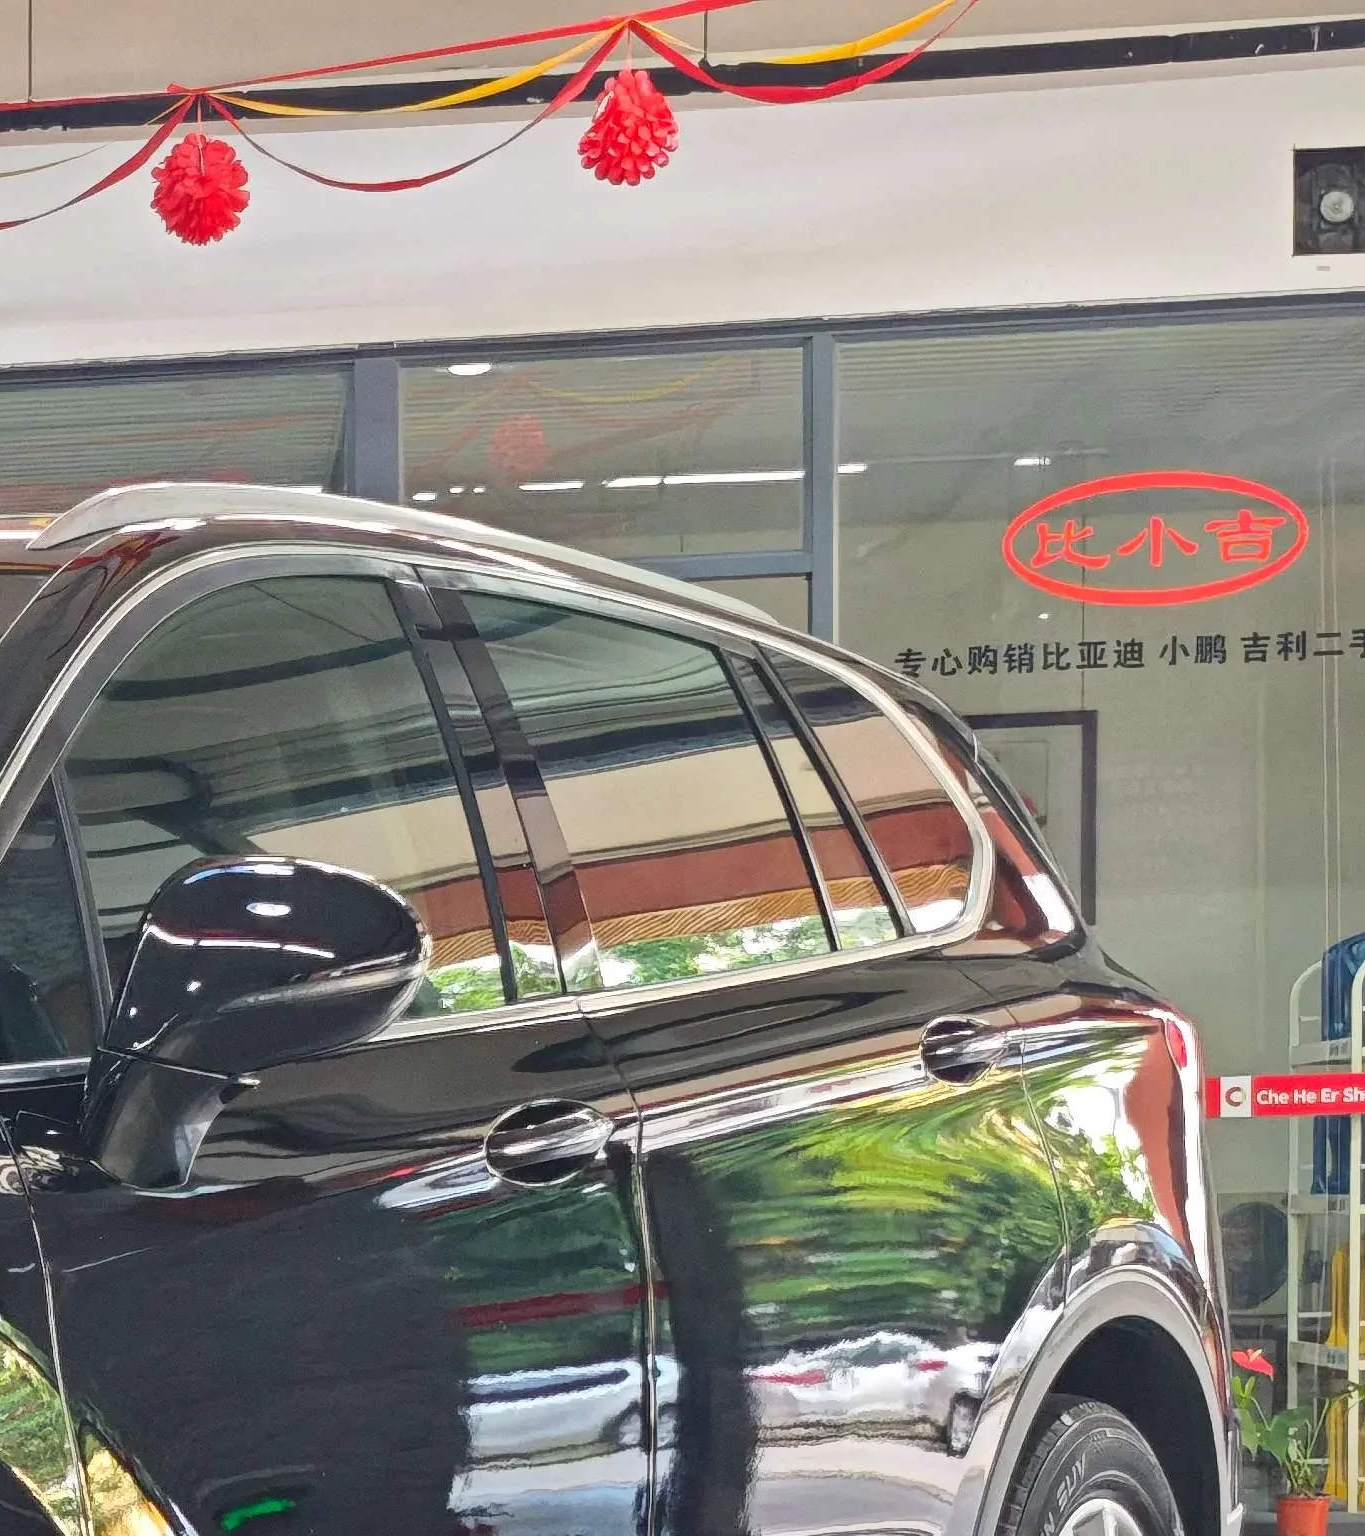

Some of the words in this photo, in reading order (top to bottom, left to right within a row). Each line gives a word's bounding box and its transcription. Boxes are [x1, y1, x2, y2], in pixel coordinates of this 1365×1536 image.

[1030, 509, 1287, 570] 比小吉
[894, 638, 1146, 679] 专心购销比亚迪
[1159, 633, 1228, 667] 小鹏
[1256, 1088, 1289, 1105] Che
[1293, 1088, 1317, 1104] He
[1321, 1088, 1339, 1103] Er
[1343, 1087, 1365, 1103] Sh
